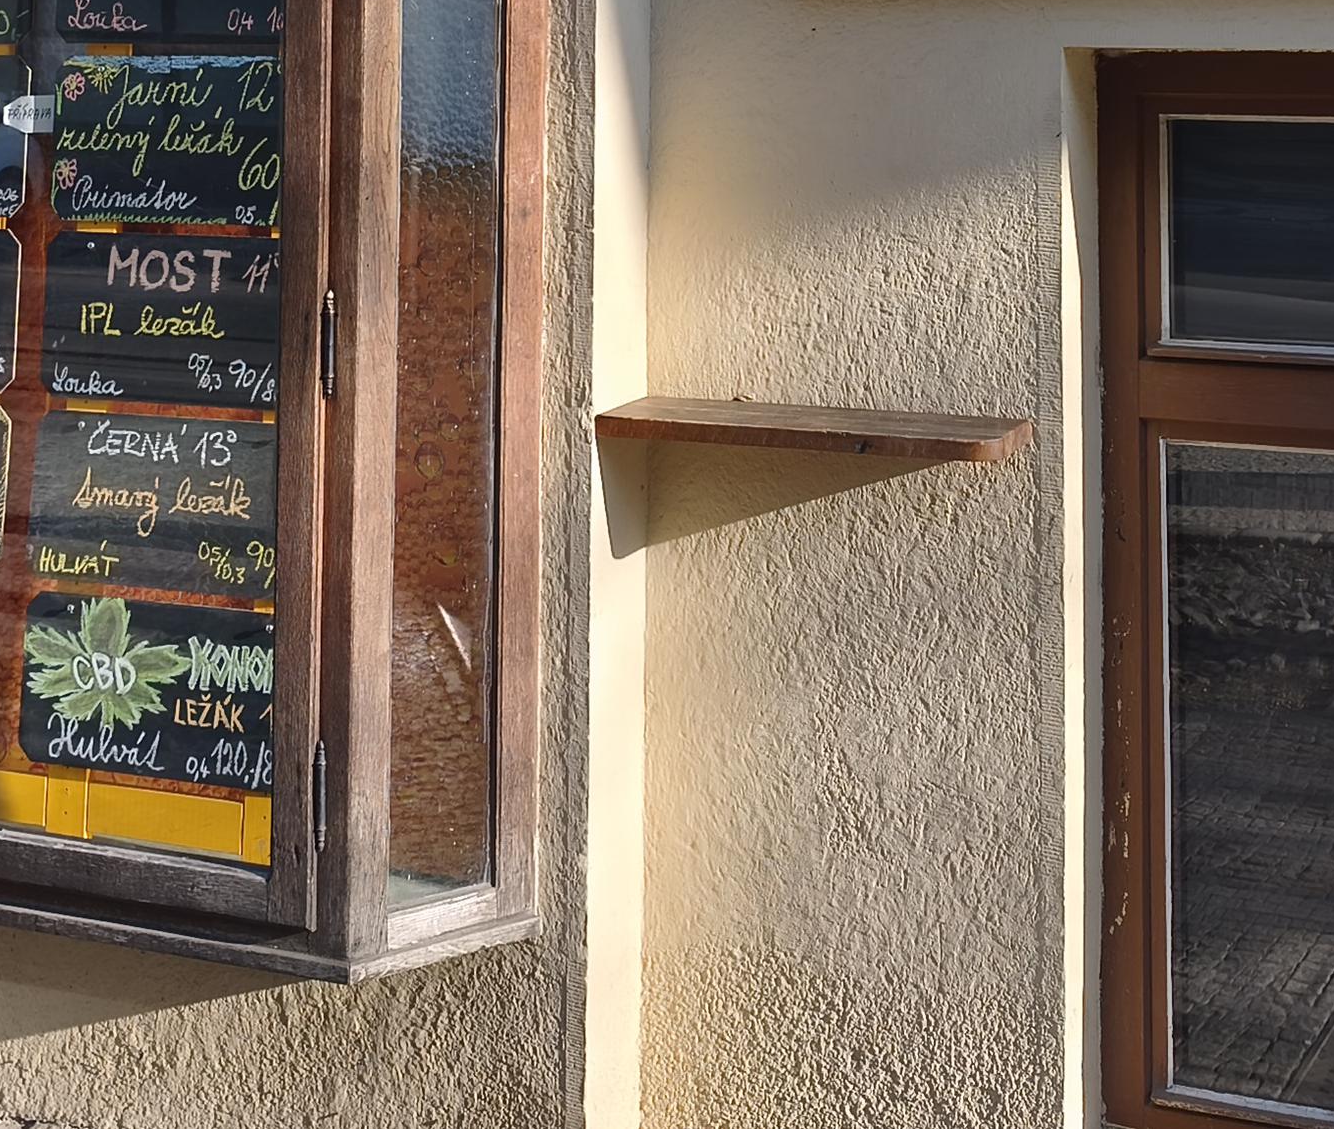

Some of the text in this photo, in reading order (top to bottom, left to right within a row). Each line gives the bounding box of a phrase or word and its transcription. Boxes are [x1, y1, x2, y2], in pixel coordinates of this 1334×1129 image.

[107, 64, 214, 131] Jarní
[107, 242, 233, 294] MOST
[79, 301, 122, 336] IPL
[51, 361, 124, 396] Louka
[87, 418, 237, 468] ČERNÁ 13°
[39, 539, 120, 577] HULVÁT
[72, 651, 138, 696] CBD
[173, 693, 245, 734] LEŽÁK
